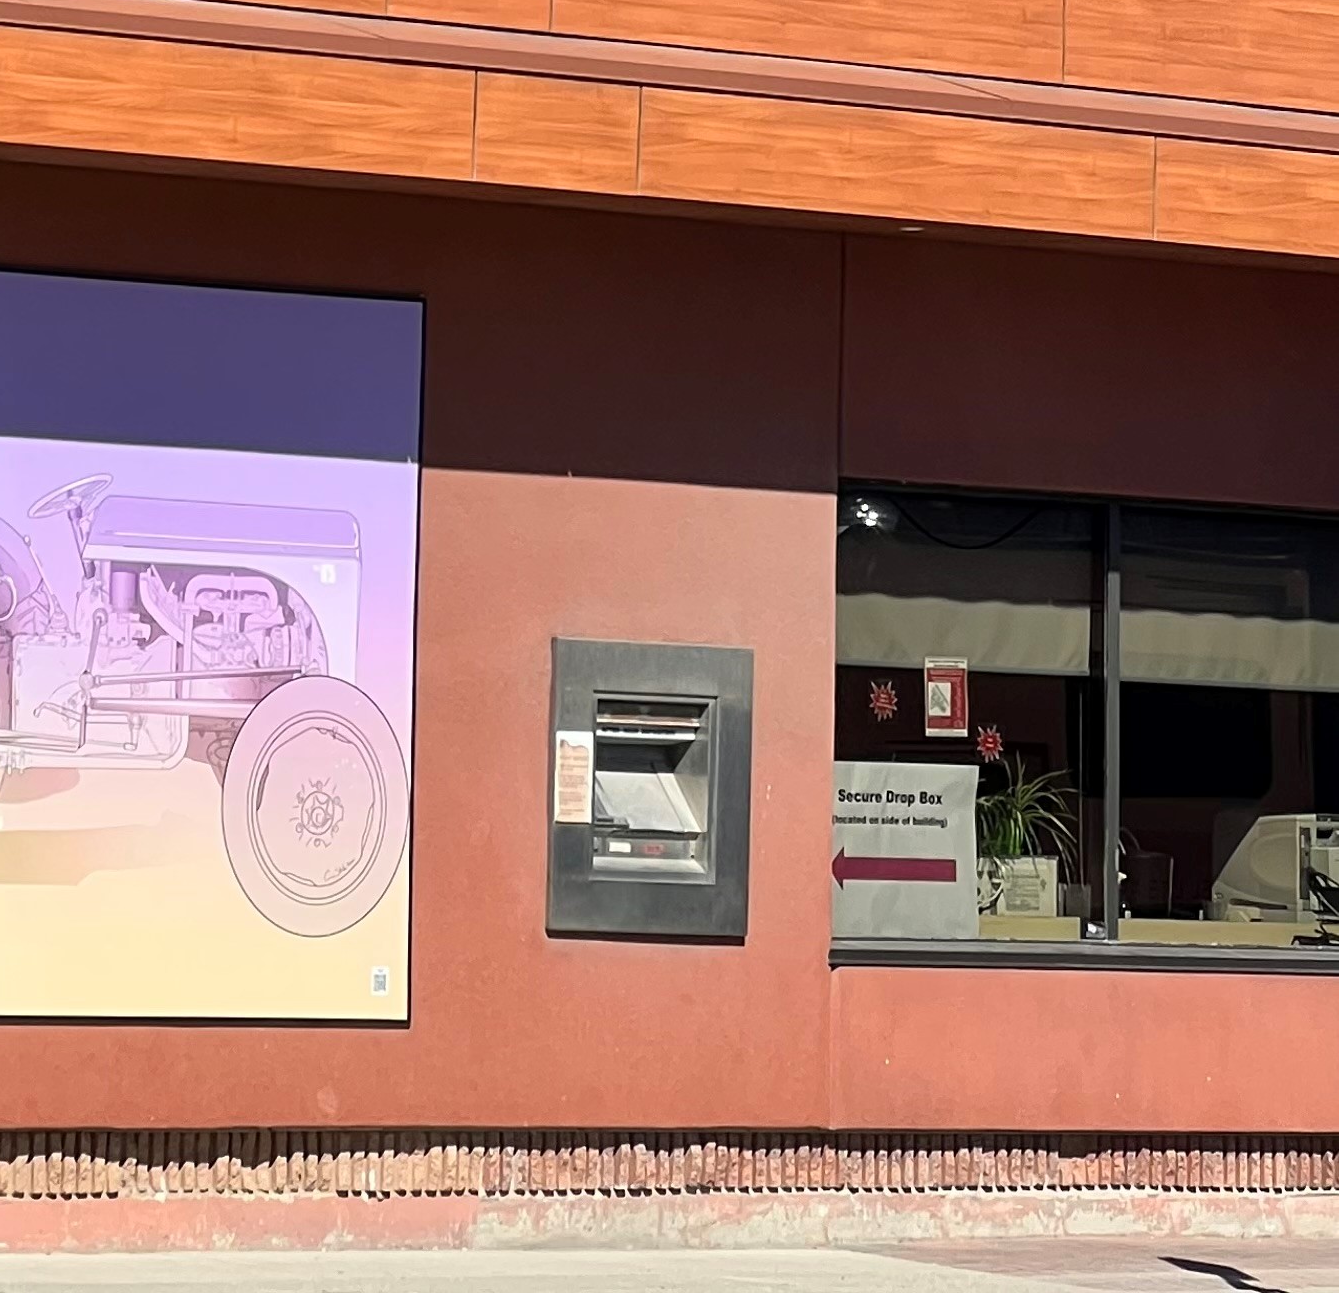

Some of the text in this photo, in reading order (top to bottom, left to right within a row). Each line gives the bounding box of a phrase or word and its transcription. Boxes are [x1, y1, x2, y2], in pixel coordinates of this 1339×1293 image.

[838, 789, 943, 807] Secure Drop Box
